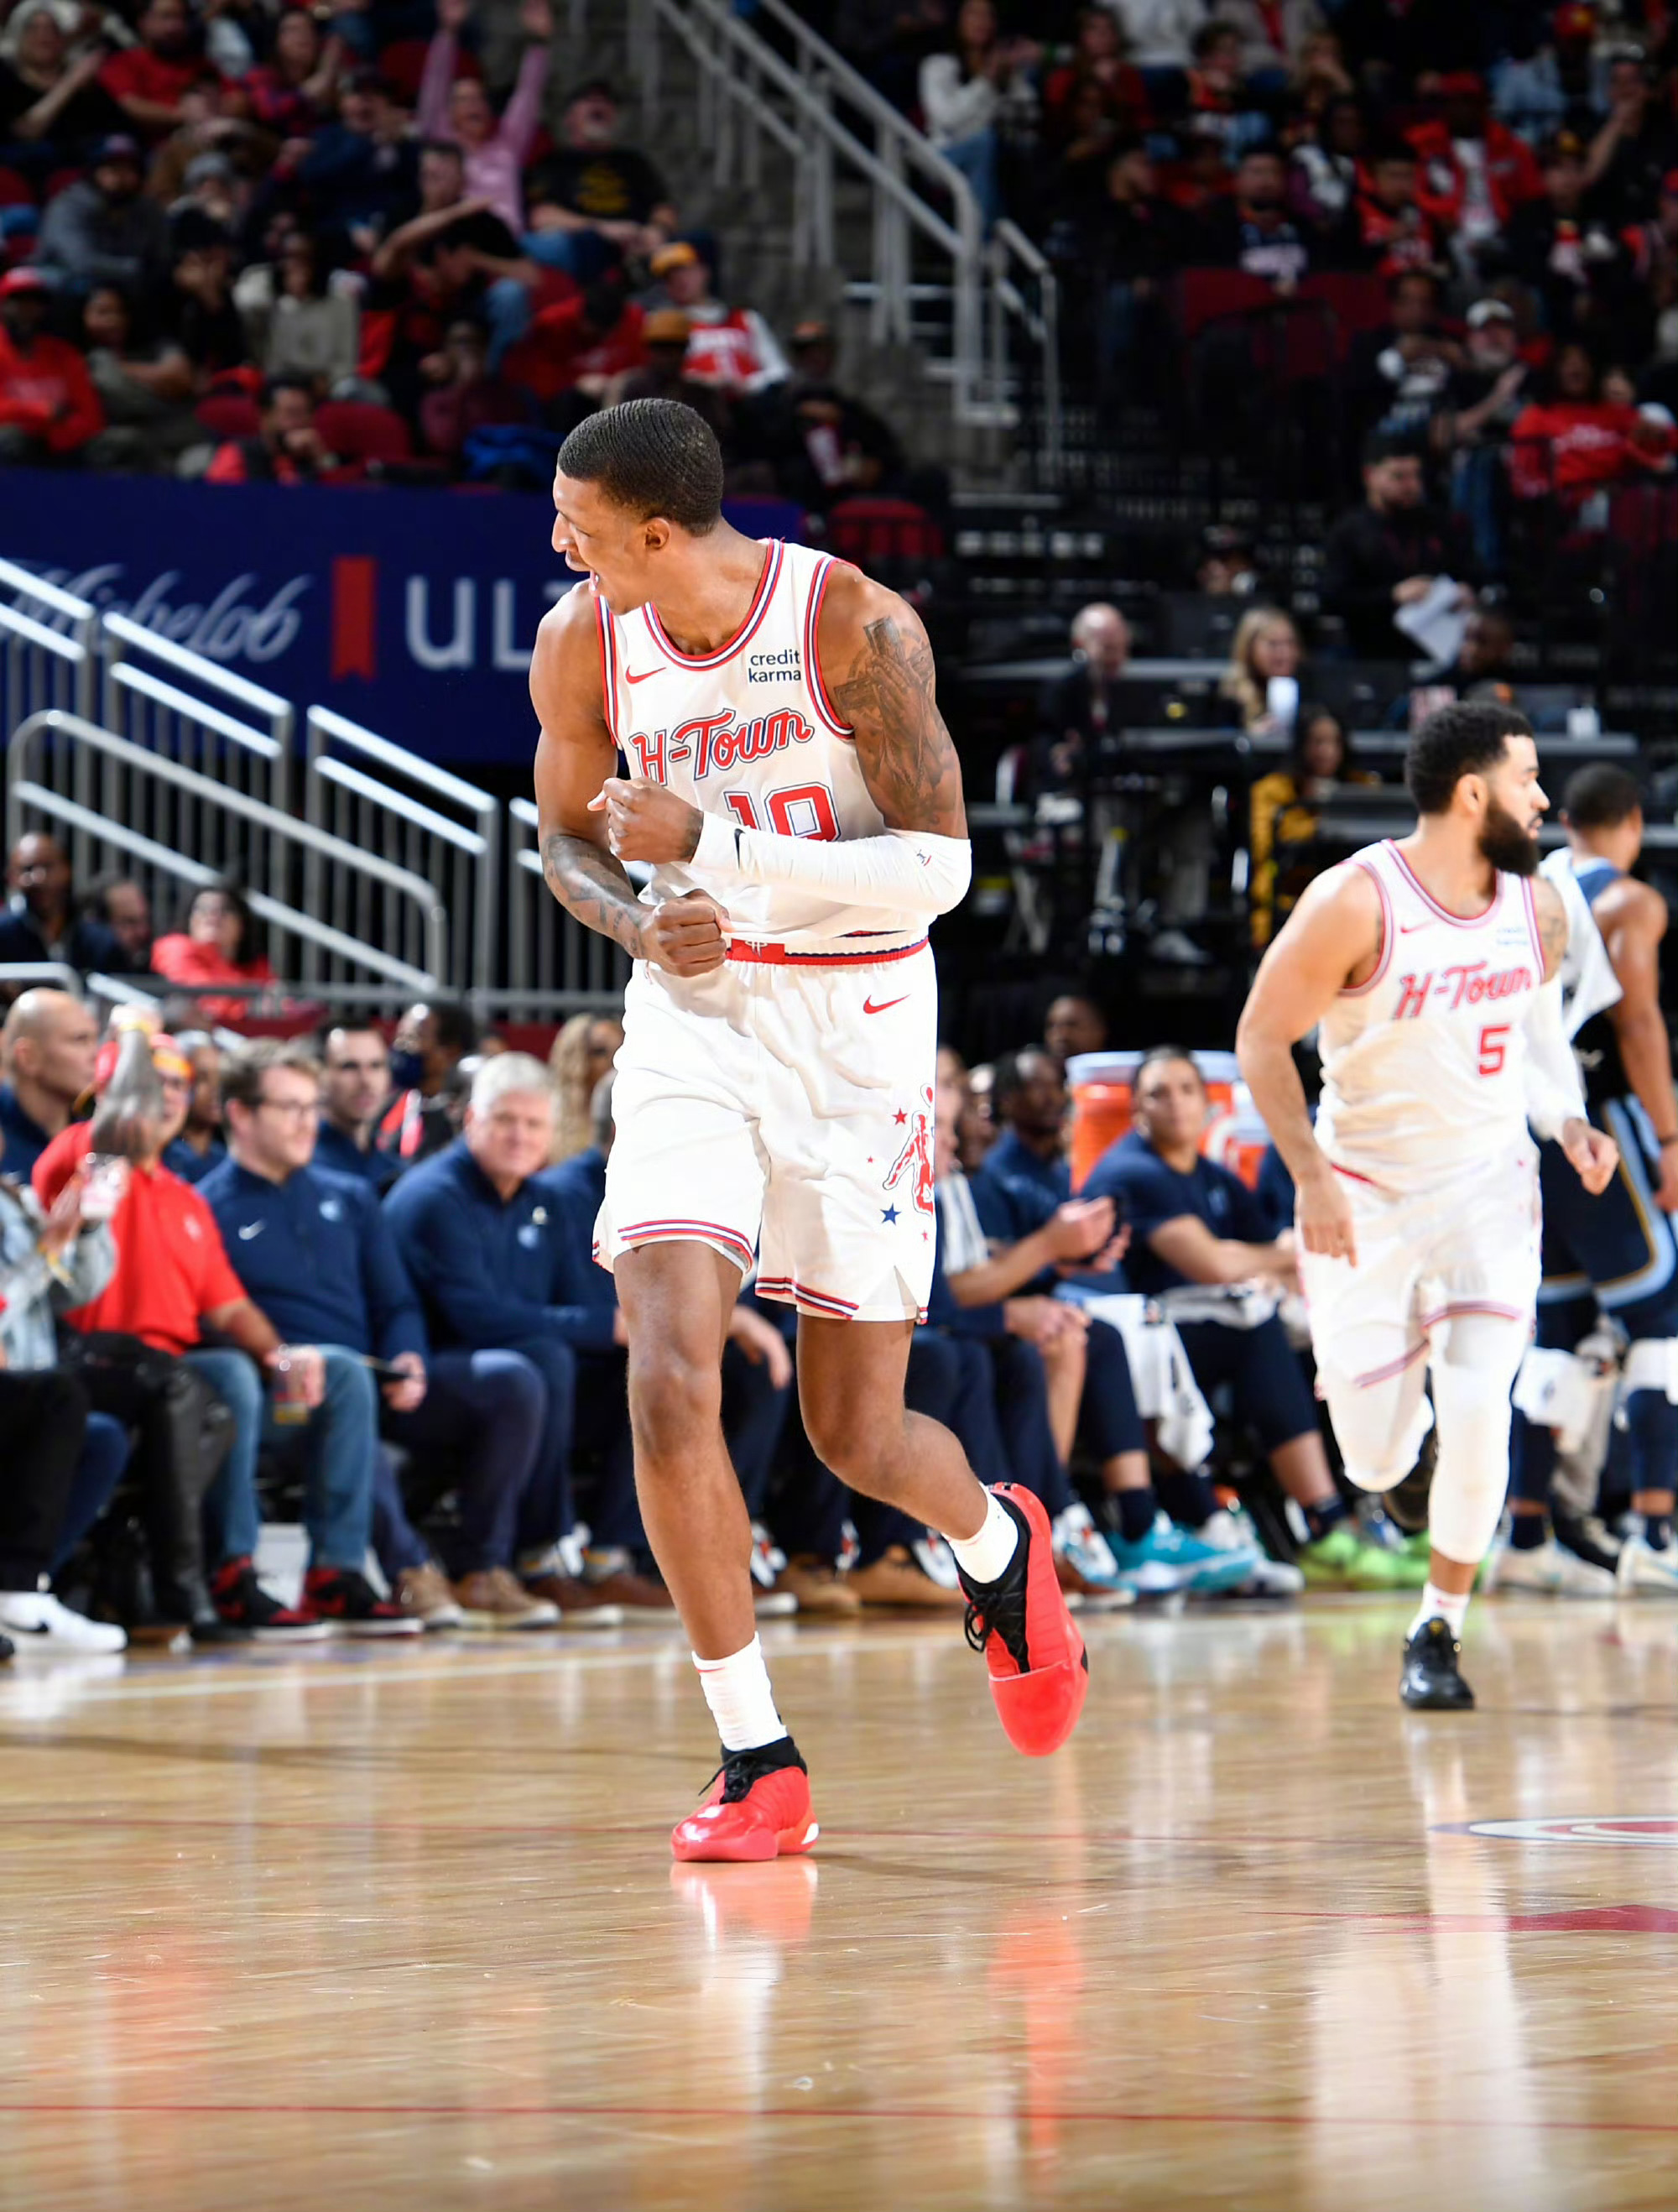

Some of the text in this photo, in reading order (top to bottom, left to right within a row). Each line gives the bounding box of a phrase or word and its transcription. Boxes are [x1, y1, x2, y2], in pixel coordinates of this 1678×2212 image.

[748, 667, 802, 683] karma
[750, 649, 800, 666] credit
[629, 707, 815, 786] H-Town
[1392, 961, 1531, 1020] H-Town
[1478, 1023, 1511, 1077] 5
